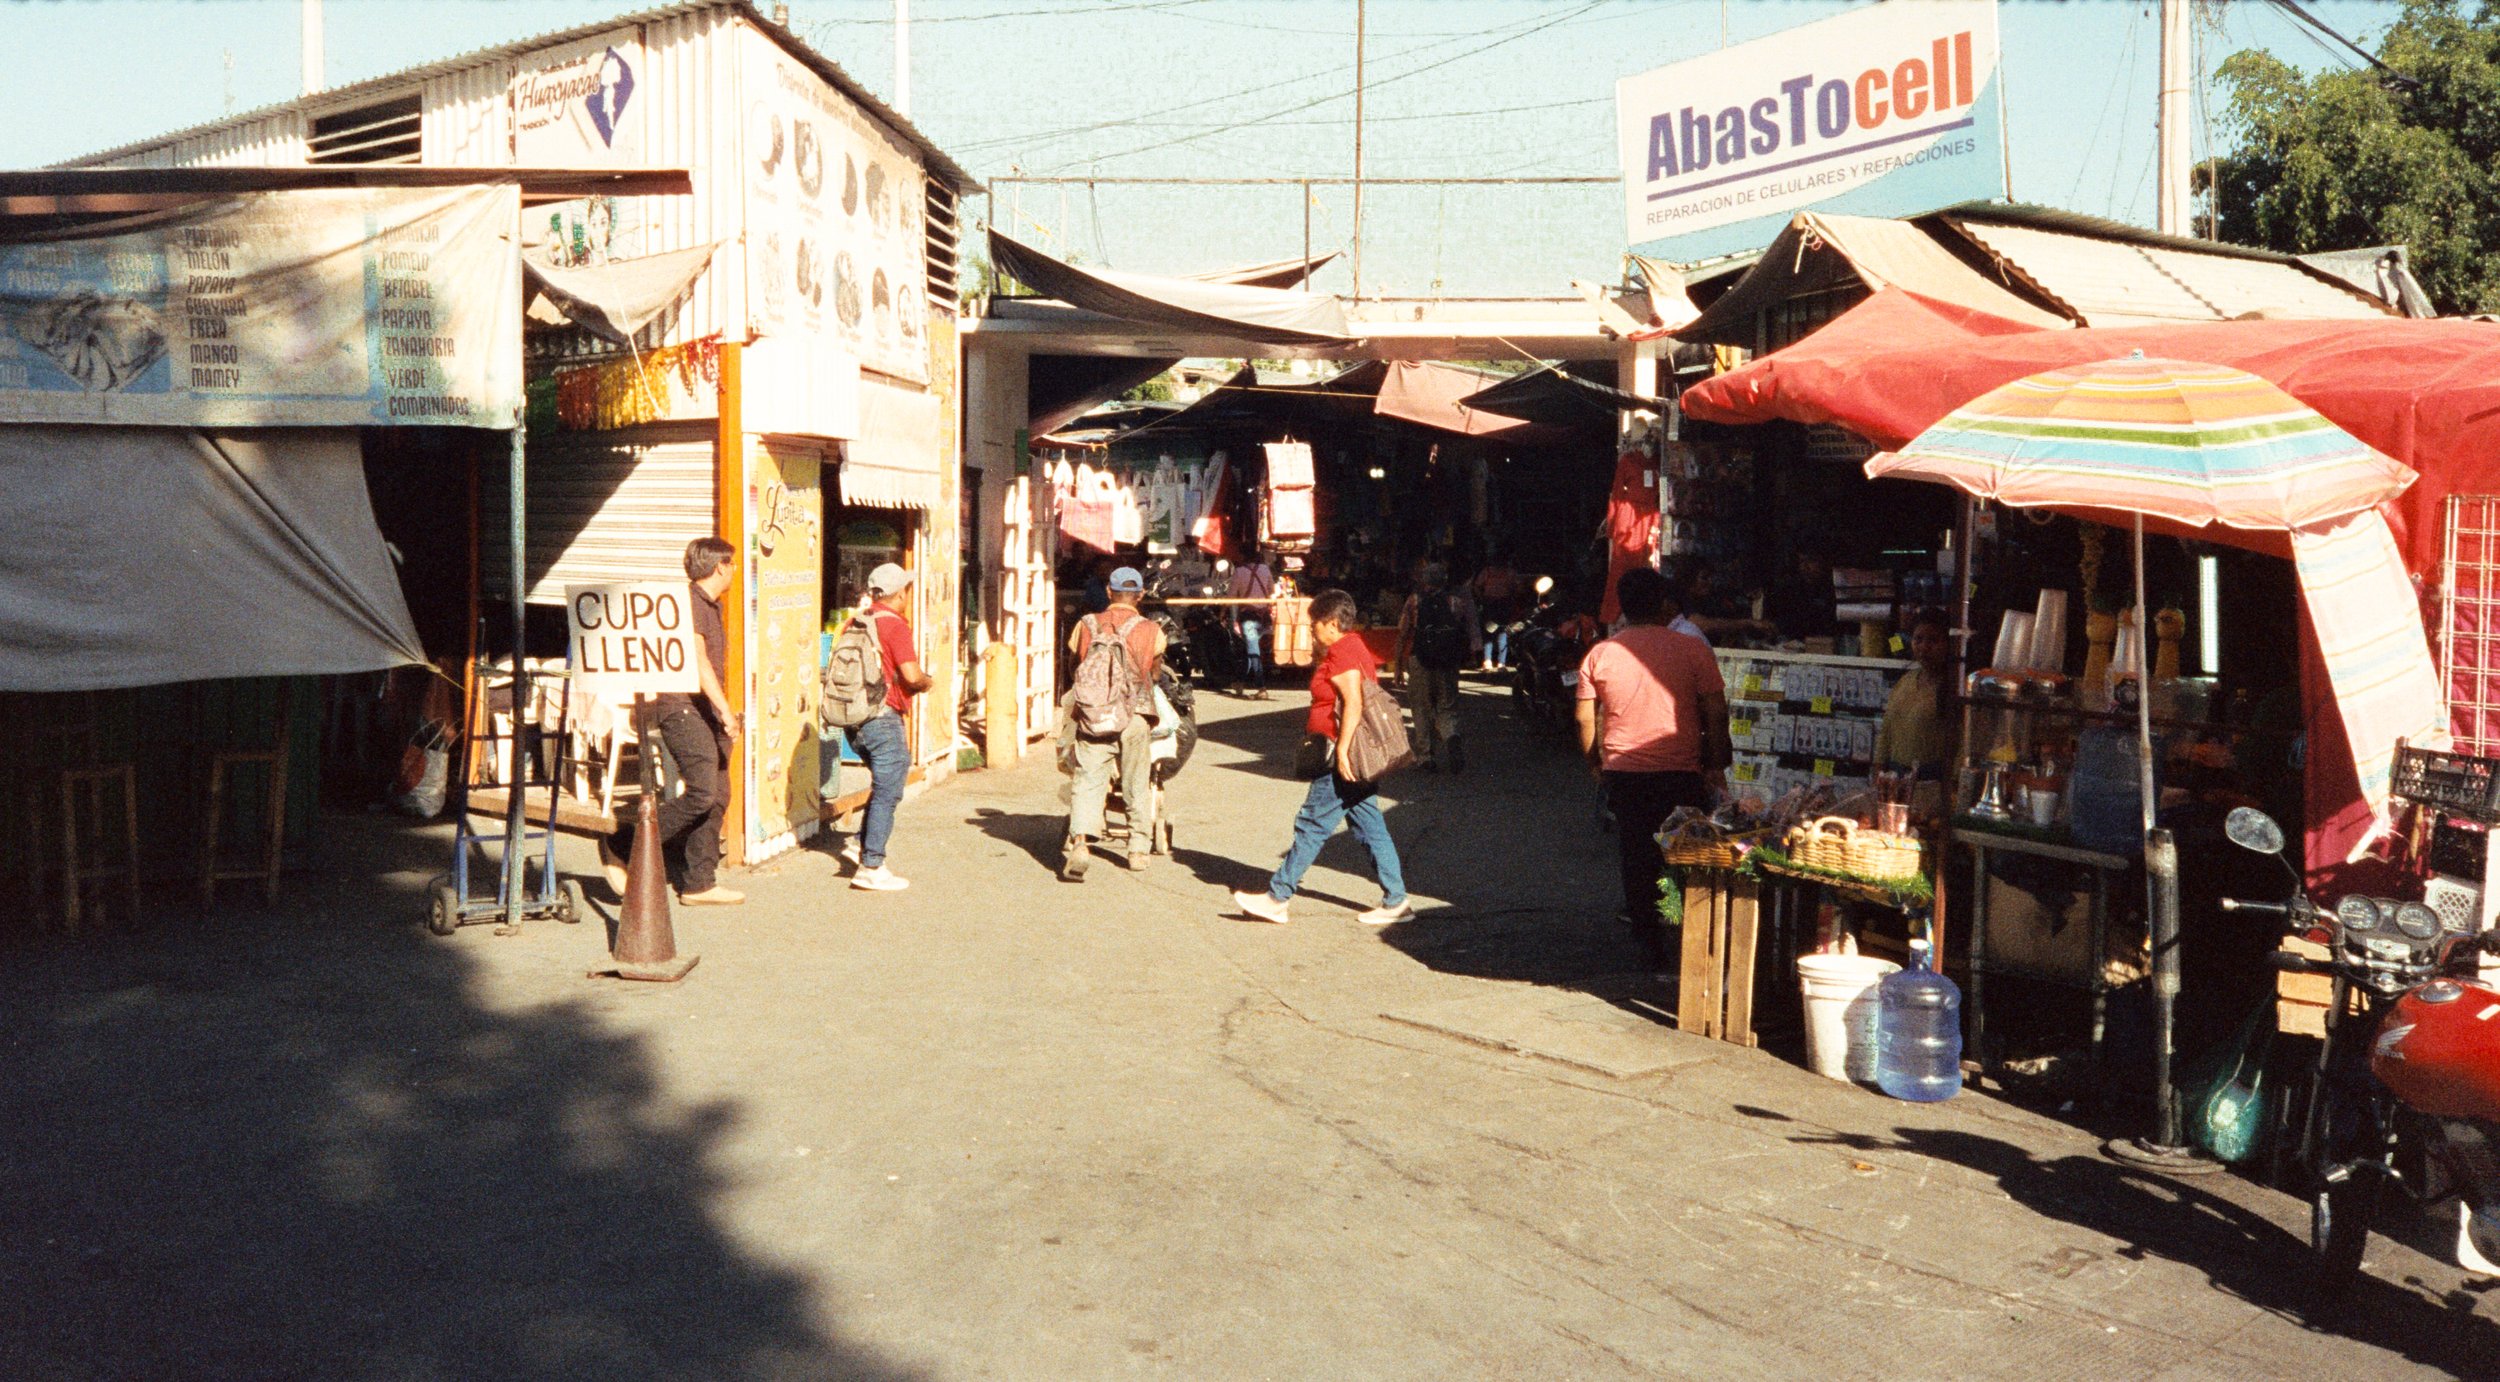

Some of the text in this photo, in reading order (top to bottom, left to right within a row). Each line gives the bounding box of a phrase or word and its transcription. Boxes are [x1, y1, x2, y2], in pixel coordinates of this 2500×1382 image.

[1647, 31, 1974, 182] AbasTocell
[1647, 138, 1976, 225] REPARACION DE CELULARES Y REFACCIONES
[381, 251, 429, 271] POMELO
[187, 274, 237, 294] PAPAYA
[384, 278, 432, 299] BETABEL
[185, 296, 248, 317] GUAYABA
[189, 318, 227, 338] FRESA
[382, 308, 432, 329] PAPAYA
[190, 344, 238, 364] MANGO
[385, 336, 455, 357] ZANAHORIA
[191, 368, 240, 388] MAMEY
[388, 368, 426, 389] VERDE
[389, 395, 470, 417] COMBINADOS
[575, 591, 680, 630] CUPO
[580, 636, 685, 673] LLENO
